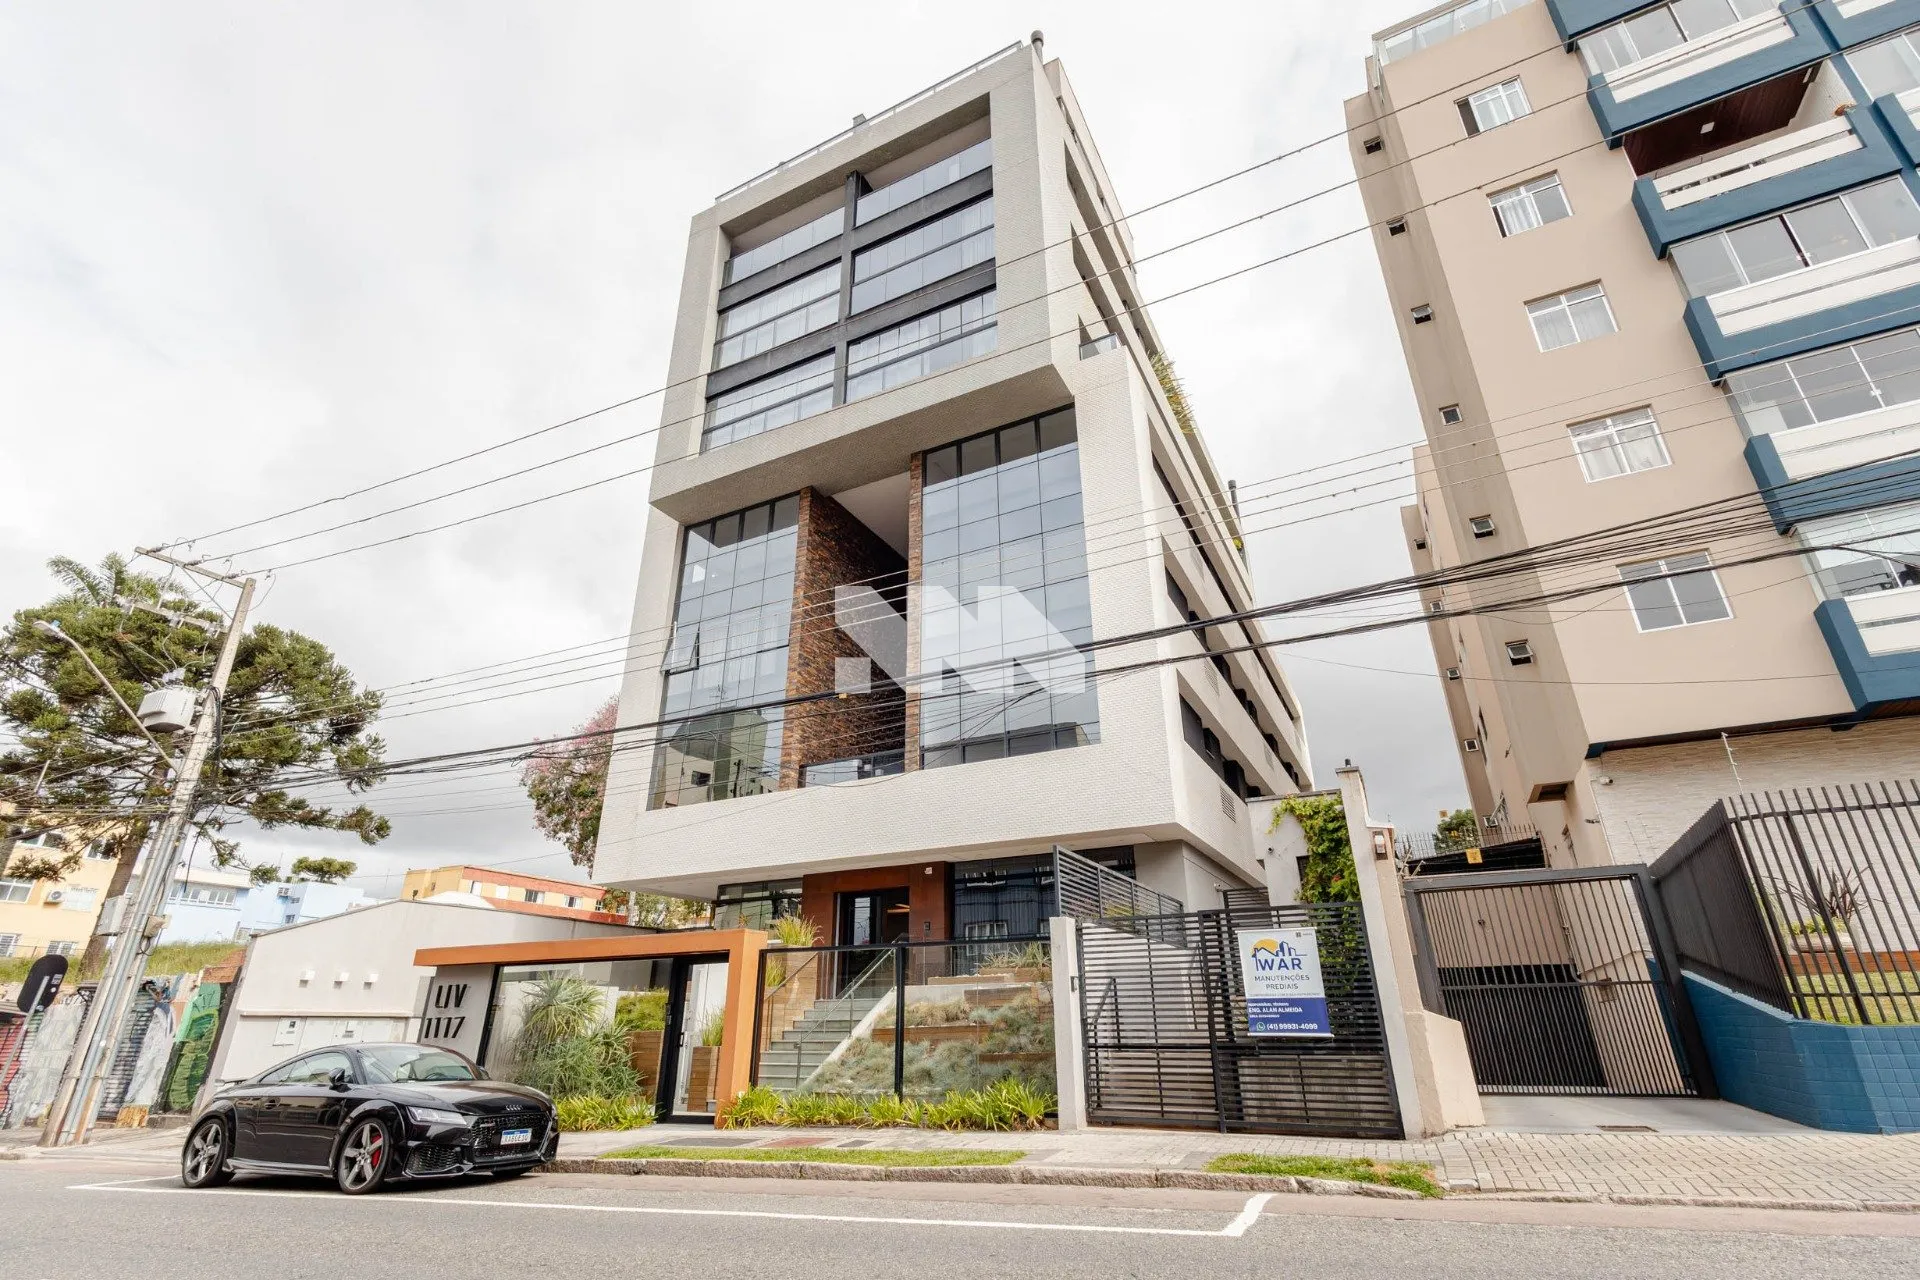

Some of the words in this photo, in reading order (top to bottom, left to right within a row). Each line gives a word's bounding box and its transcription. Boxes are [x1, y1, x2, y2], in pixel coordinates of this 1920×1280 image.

[1257, 957, 1302, 971] WAR
[1254, 973, 1310, 982] MANUTENÇÕES
[435, 984, 468, 1009] LIV
[424, 1016, 466, 1039] 1117
